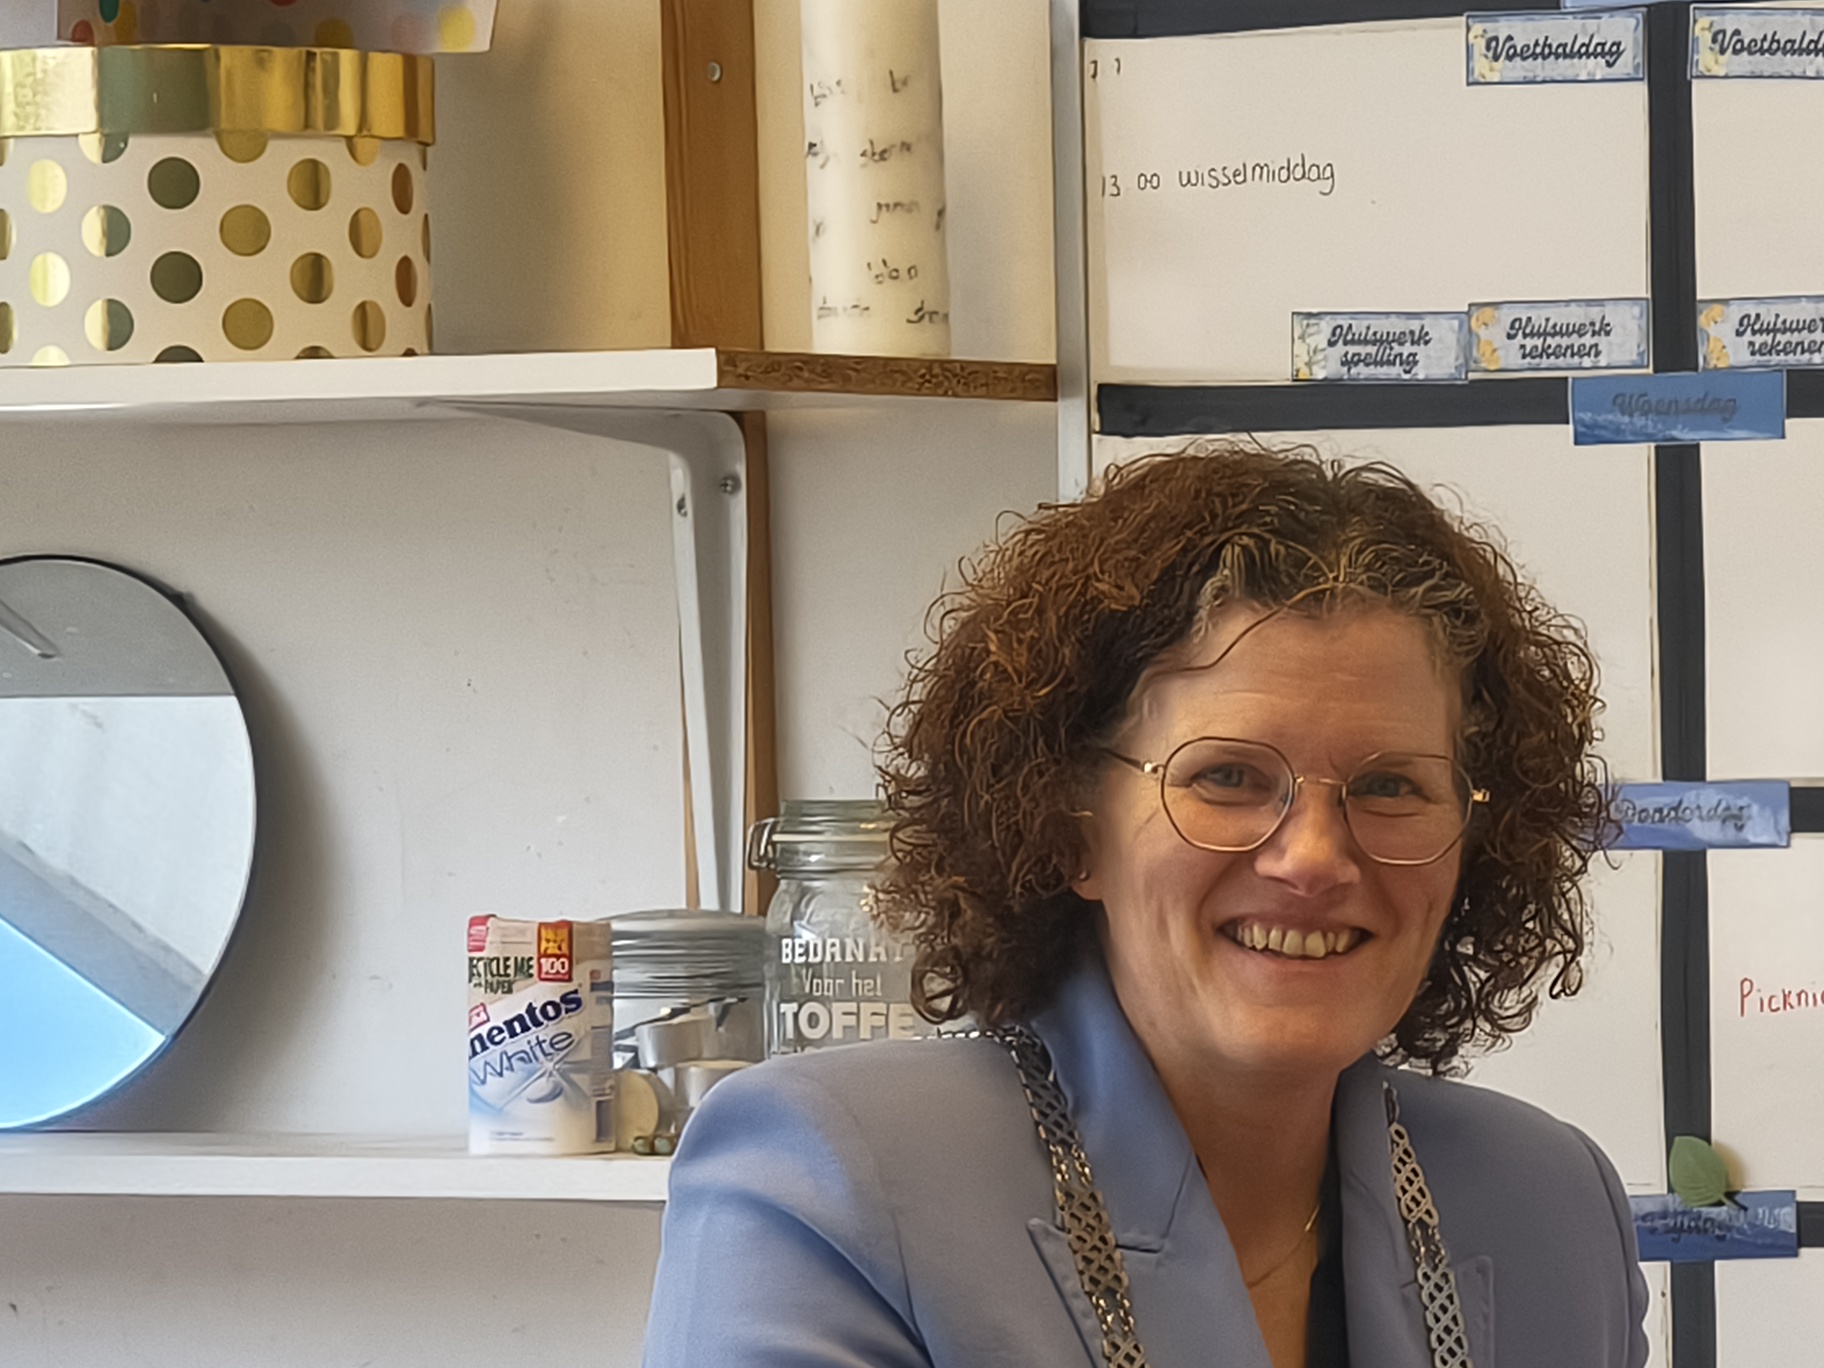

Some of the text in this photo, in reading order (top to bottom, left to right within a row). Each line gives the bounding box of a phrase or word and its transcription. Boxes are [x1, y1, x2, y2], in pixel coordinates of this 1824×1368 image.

[1485, 34, 1627, 68] Voetbaldag
[1178, 154, 1336, 196] wisselmiddag
[1327, 322, 1432, 349] Huiswerk
[1506, 313, 1613, 341] Huiswerk
[1340, 346, 1420, 375] spelling
[1519, 340, 1601, 361] rekenen
[1612, 390, 1738, 424] Woensdag
[540, 957, 569, 974] 100
[851, 969, 882, 997] het
[469, 1030, 575, 1086] White
